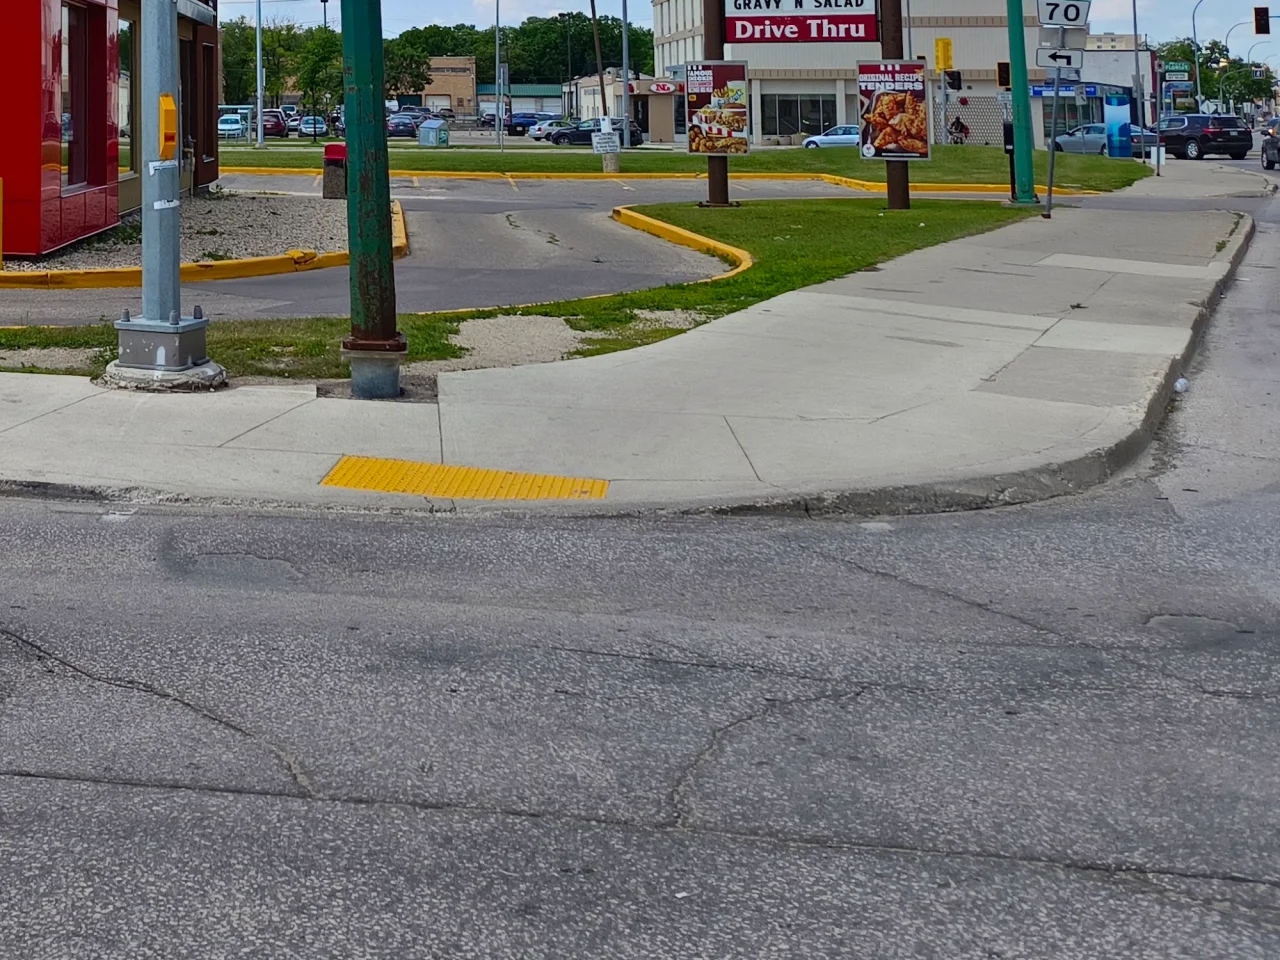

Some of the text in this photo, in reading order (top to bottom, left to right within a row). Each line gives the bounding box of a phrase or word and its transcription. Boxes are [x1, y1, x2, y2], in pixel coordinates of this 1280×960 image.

[1045, 2, 1080, 22] 70
[734, 18, 866, 39] Drive Thru
[859, 73, 923, 82] ORIGINAL RECIPE
[859, 82, 924, 91] TENDERS
